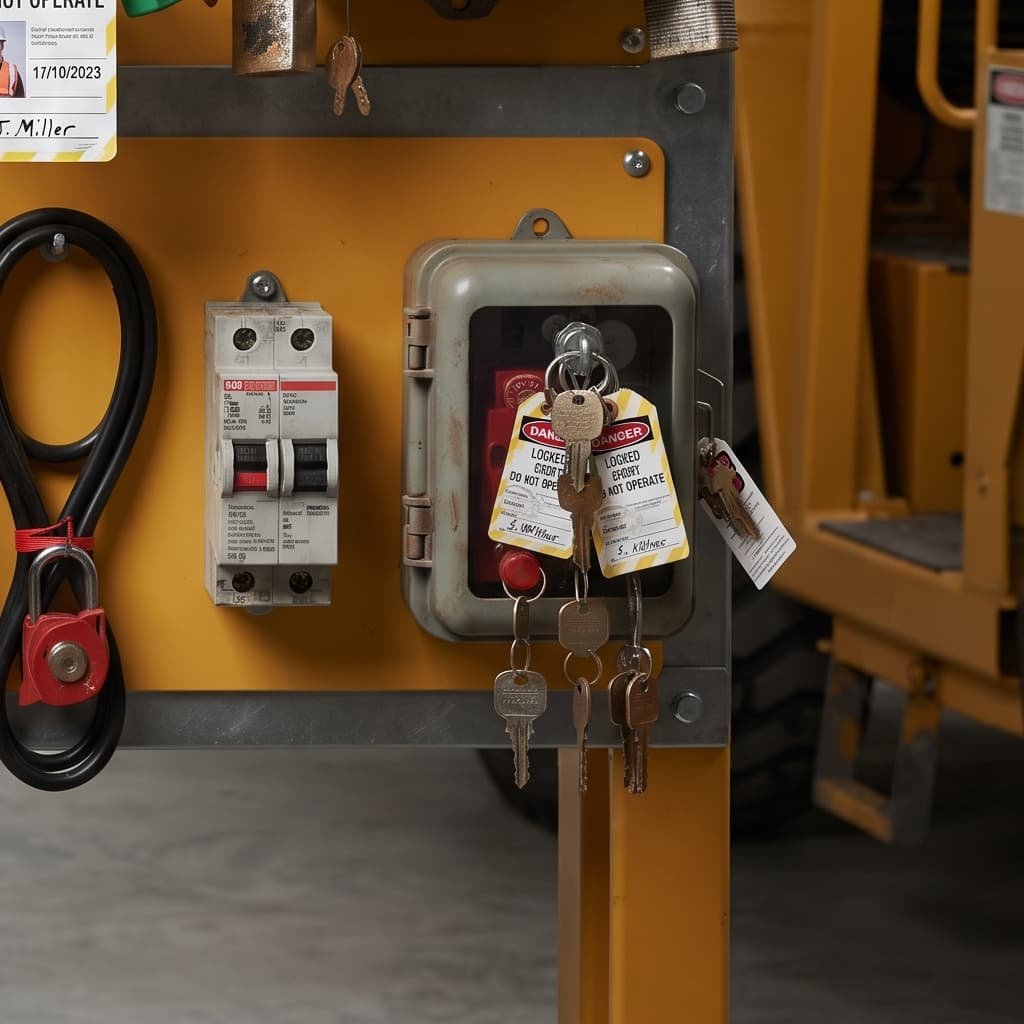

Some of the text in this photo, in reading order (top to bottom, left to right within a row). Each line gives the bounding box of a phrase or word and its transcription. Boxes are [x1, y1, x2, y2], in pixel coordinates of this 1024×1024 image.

[34, 66, 101, 79] 17/10/2023
[15, 118, 76, 137] Miller
[625, 472, 666, 492] OPERATE
